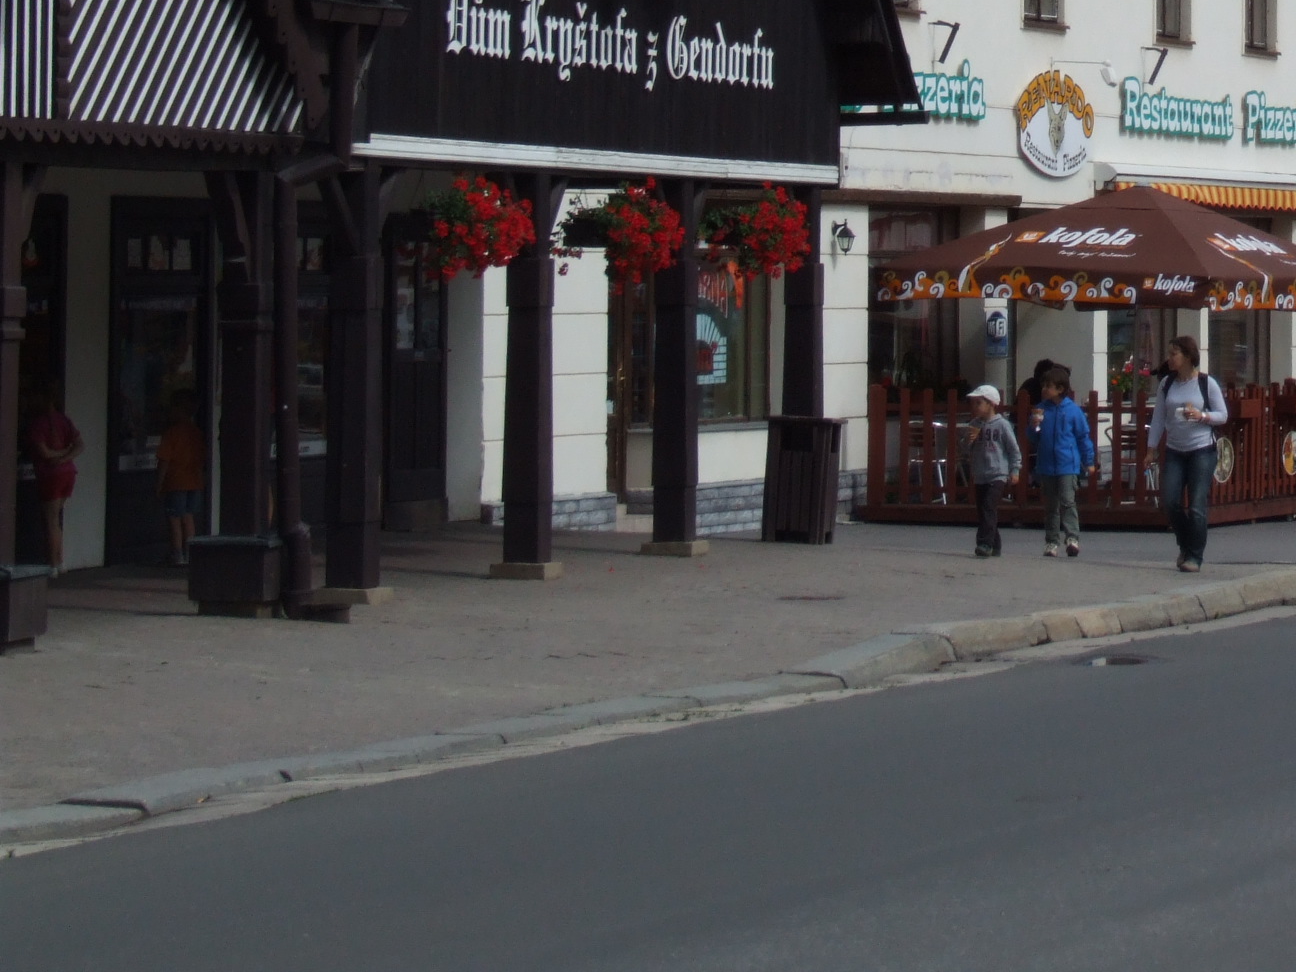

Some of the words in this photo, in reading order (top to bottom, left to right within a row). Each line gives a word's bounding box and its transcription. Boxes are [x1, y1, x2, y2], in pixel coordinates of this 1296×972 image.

[645, 31, 659, 92] z
[667, 14, 774, 90] Gendorfu
[1018, 69, 1094, 139] RENARDO
[1123, 76, 1234, 140] Restaurant
[1024, 131, 1058, 171] Restaurant
[1039, 227, 1137, 248] kofola
[1154, 273, 1196, 296] kofola
